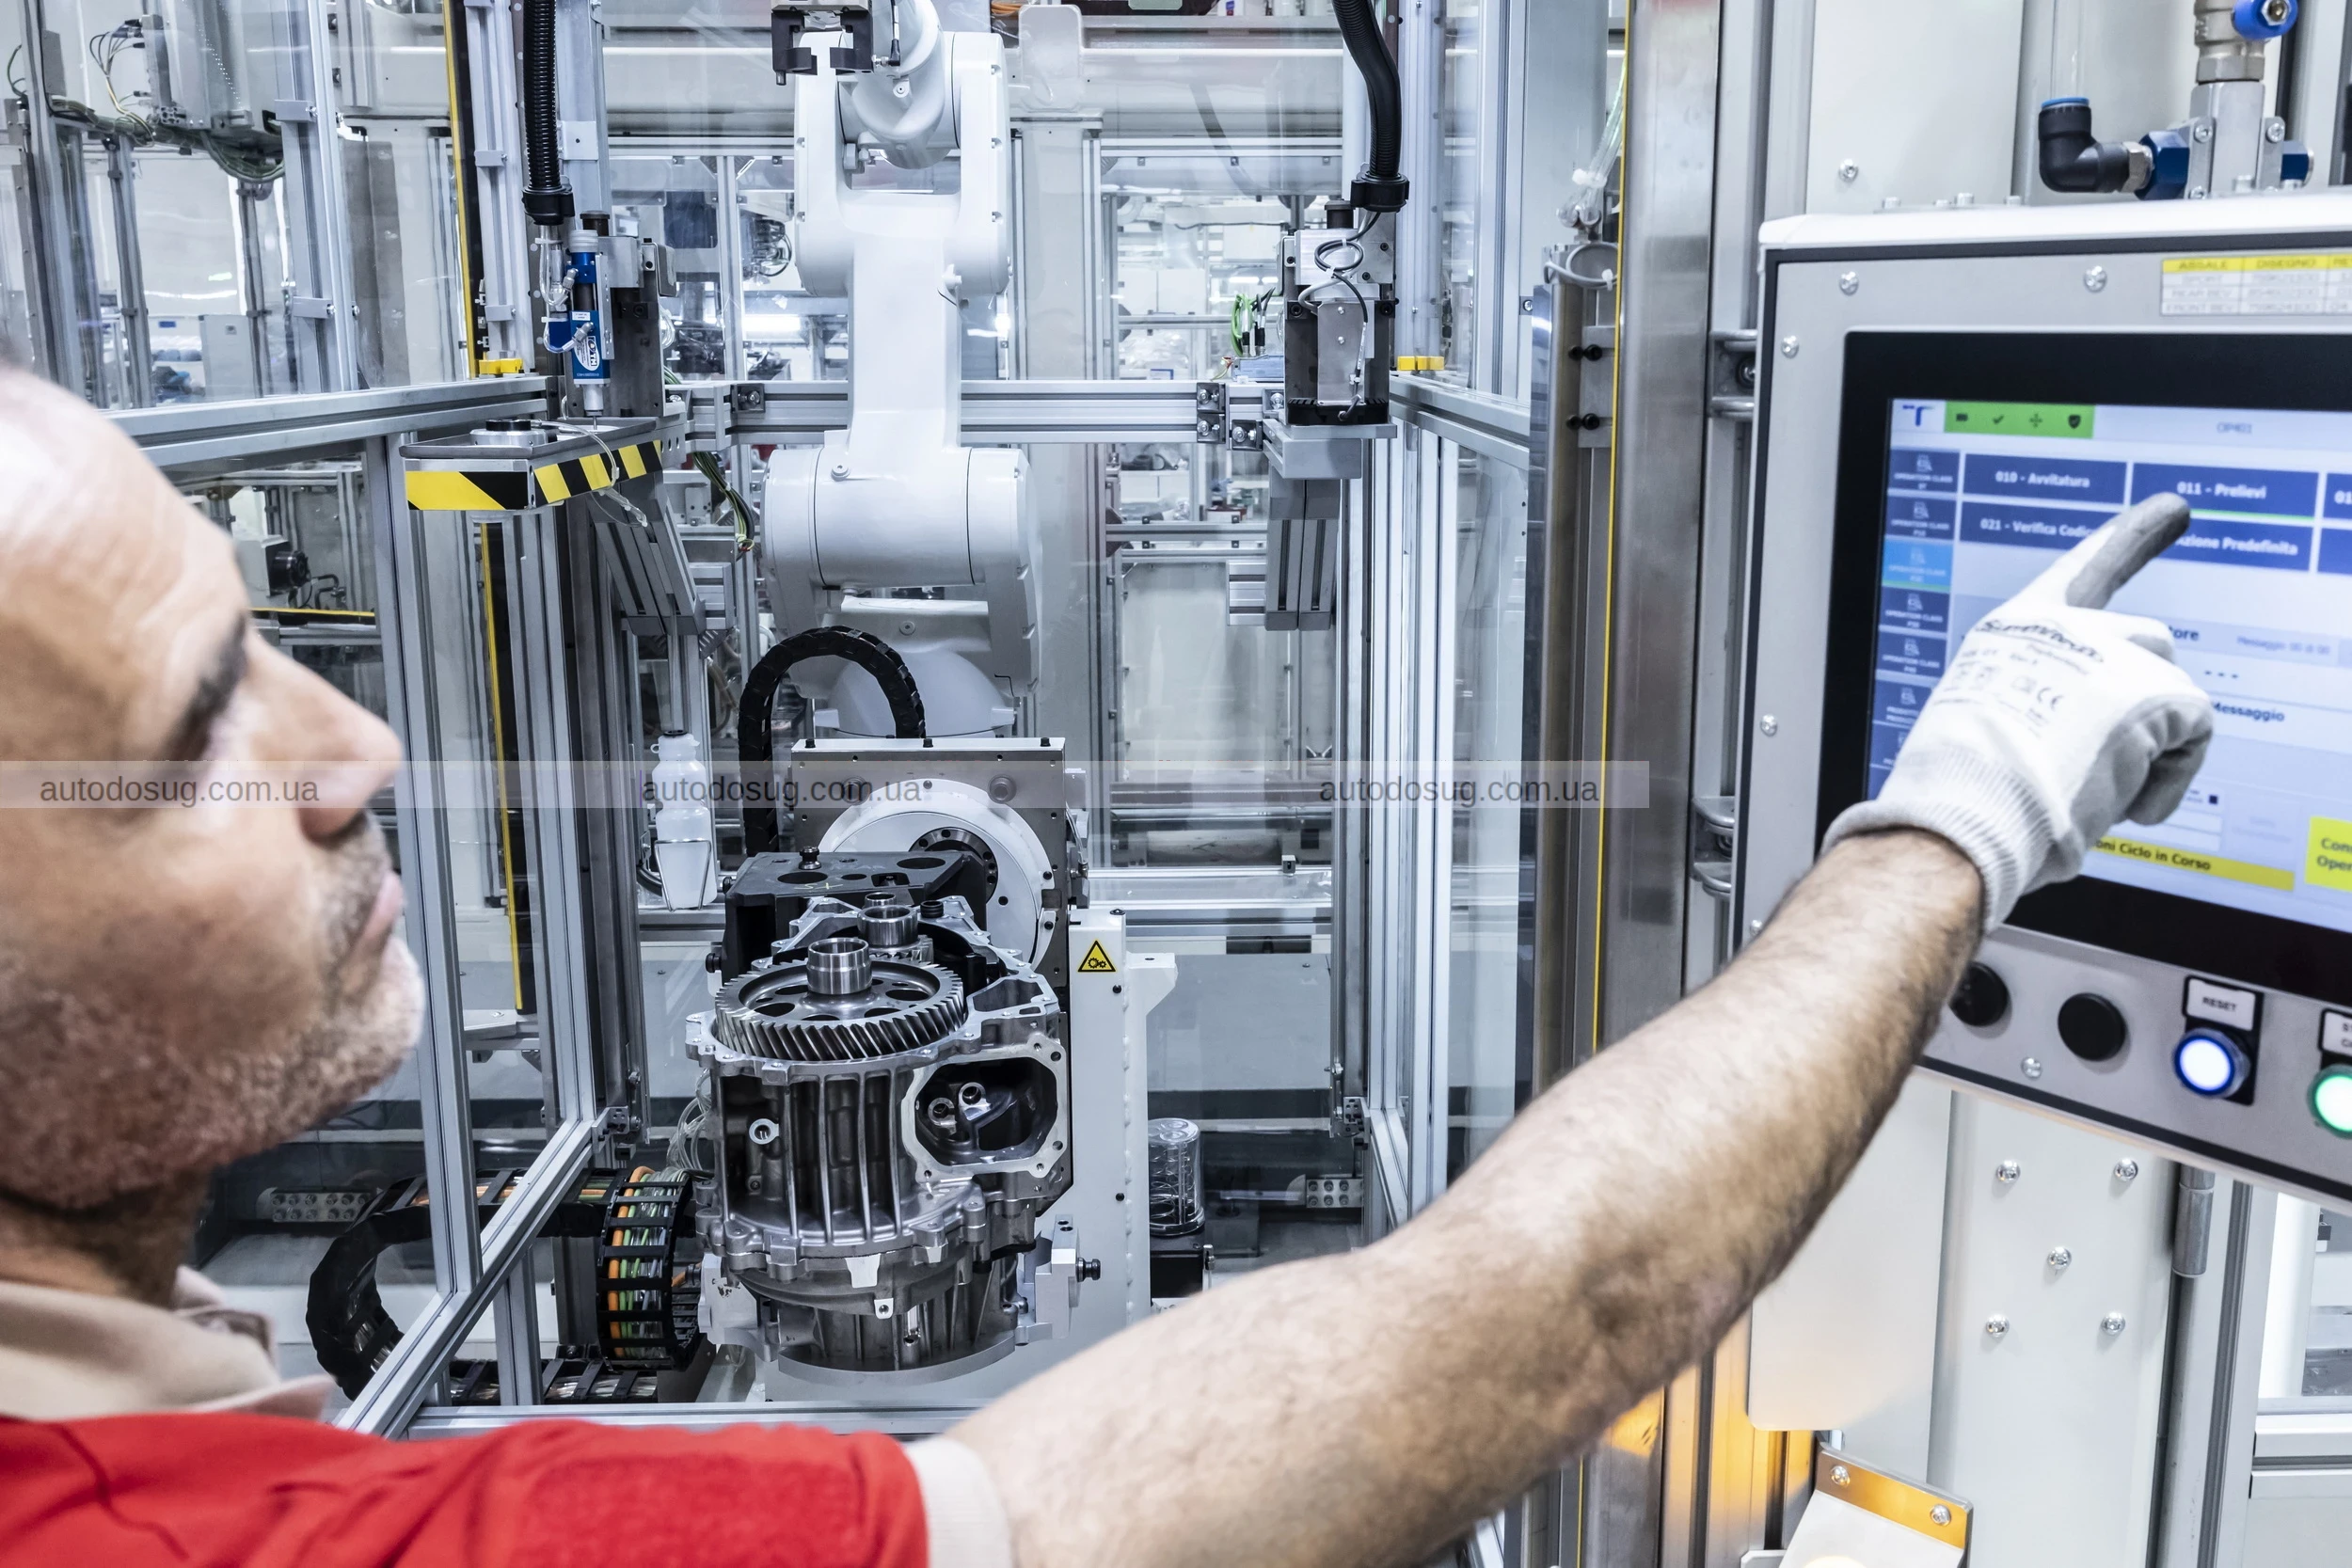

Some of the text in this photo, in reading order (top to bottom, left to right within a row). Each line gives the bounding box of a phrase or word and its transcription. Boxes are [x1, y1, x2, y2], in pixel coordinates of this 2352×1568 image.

[2027, 472, 2090, 488] Avvitatura
[2176, 482, 2201, 496] 011
[2214, 483, 2266, 499] Prelievi
[1980, 518, 2001, 531] 021
[2012, 520, 2057, 535] Verifica
[2222, 536, 2298, 556] Predefinita
[2168, 625, 2199, 641] ore
[2120, 843, 2152, 859] Ciclo
[2155, 850, 2168, 862] in
[2171, 853, 2211, 871] Corso
[2202, 997, 2237, 1011] RESET
